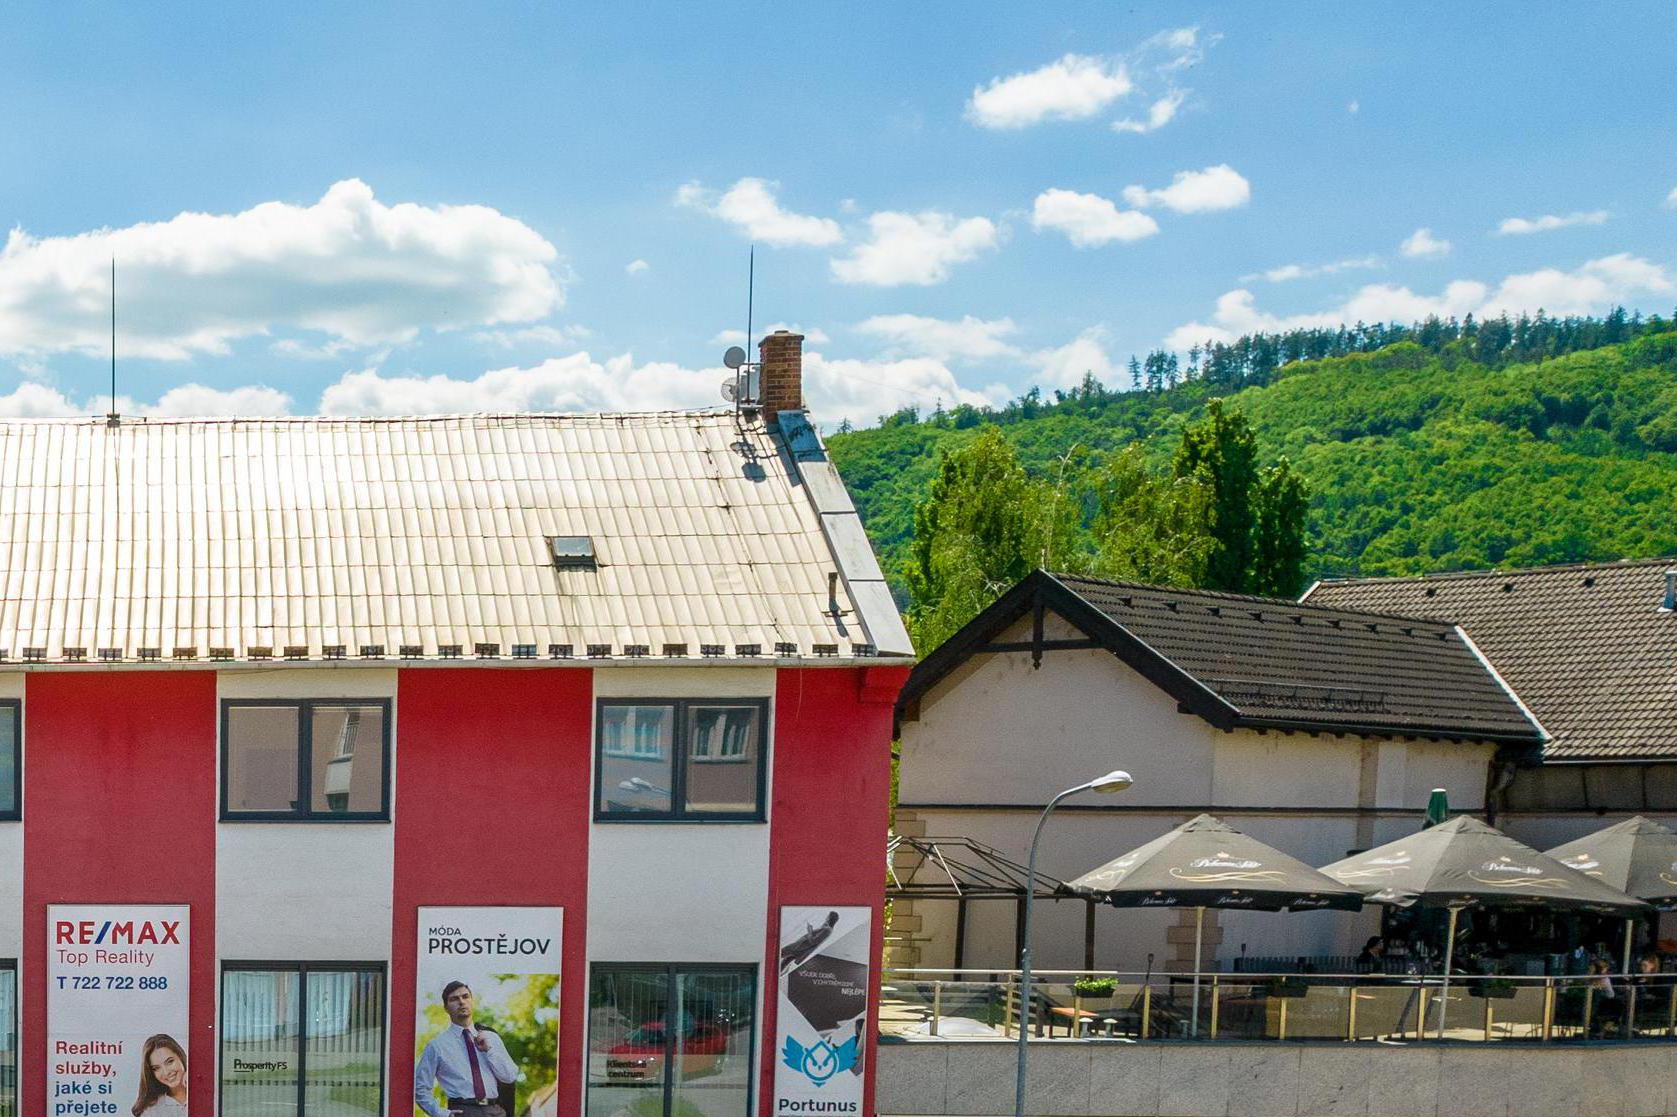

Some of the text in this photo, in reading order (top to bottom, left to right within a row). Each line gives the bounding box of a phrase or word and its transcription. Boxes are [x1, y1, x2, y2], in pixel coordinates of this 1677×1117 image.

[56, 921, 180, 944] RE/MAX
[429, 925, 462, 936] MÓDA
[429, 933, 551, 955] PROSTĚJOV
[56, 949, 155, 967] Top Reality
[56, 976, 167, 989] T 722 722 888
[56, 1041, 123, 1054] Realitní
[55, 1060, 116, 1077] služby,
[234, 1059, 288, 1072] Prosperity FS
[55, 1081, 112, 1097] jaké si
[56, 1100, 117, 1116] přejete
[779, 1099, 857, 1112] Portunus
